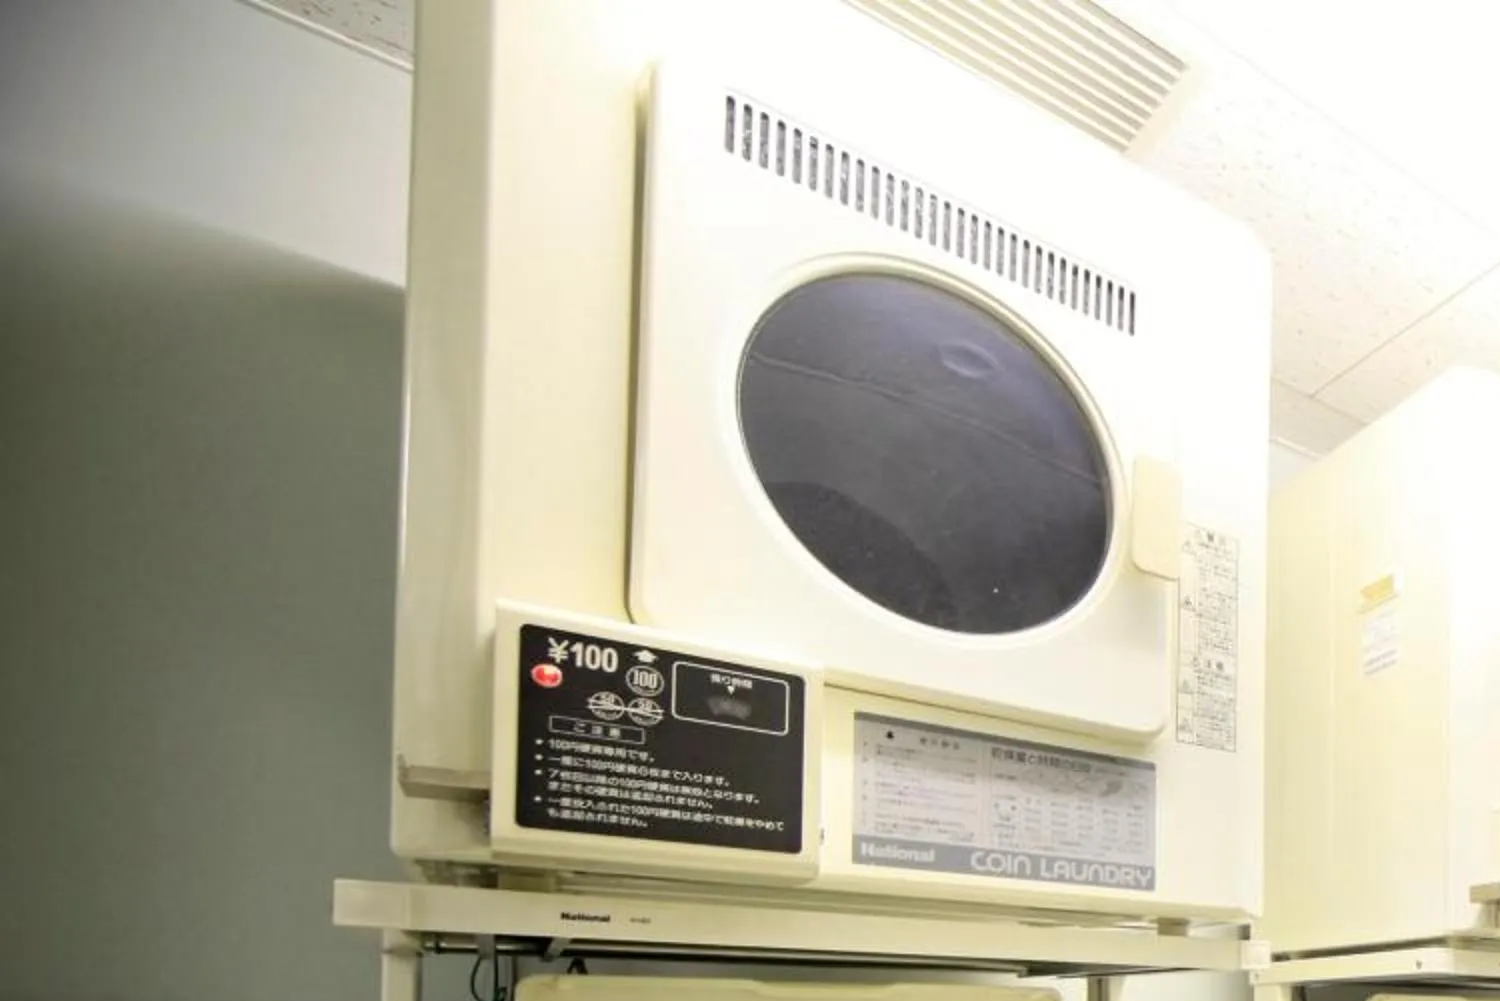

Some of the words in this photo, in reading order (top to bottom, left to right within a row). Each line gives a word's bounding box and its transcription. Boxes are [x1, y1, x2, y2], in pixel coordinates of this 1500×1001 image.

[548, 637, 619, 673] ¥100
[633, 669, 657, 690] 100
[861, 842, 936, 863] National
[970, 851, 1032, 876] COIN
[1040, 860, 1152, 887] LAUNDRY
